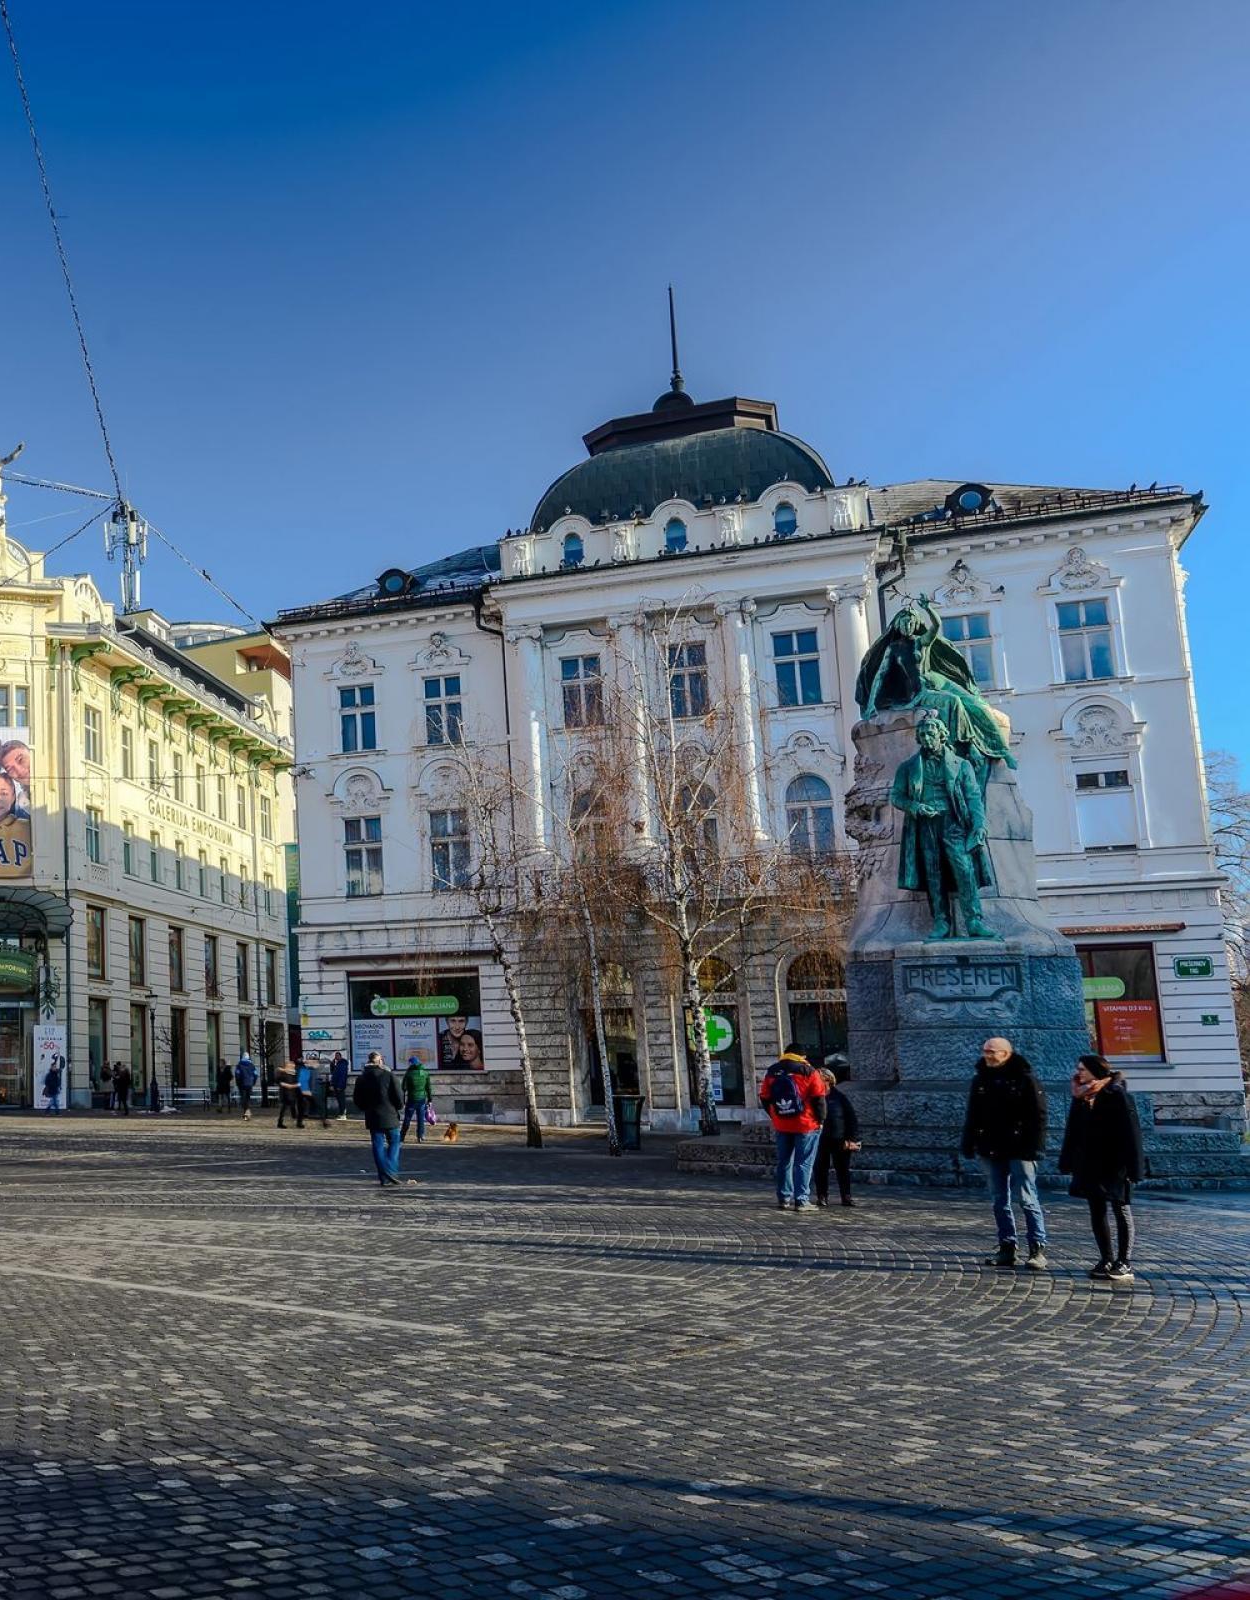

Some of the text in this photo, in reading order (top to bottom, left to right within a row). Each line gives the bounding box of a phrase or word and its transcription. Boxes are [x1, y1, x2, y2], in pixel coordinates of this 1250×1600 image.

[148, 799, 233, 846] GALERIJA EMPORIUM
[403, 1020, 427, 1028] VICHY
